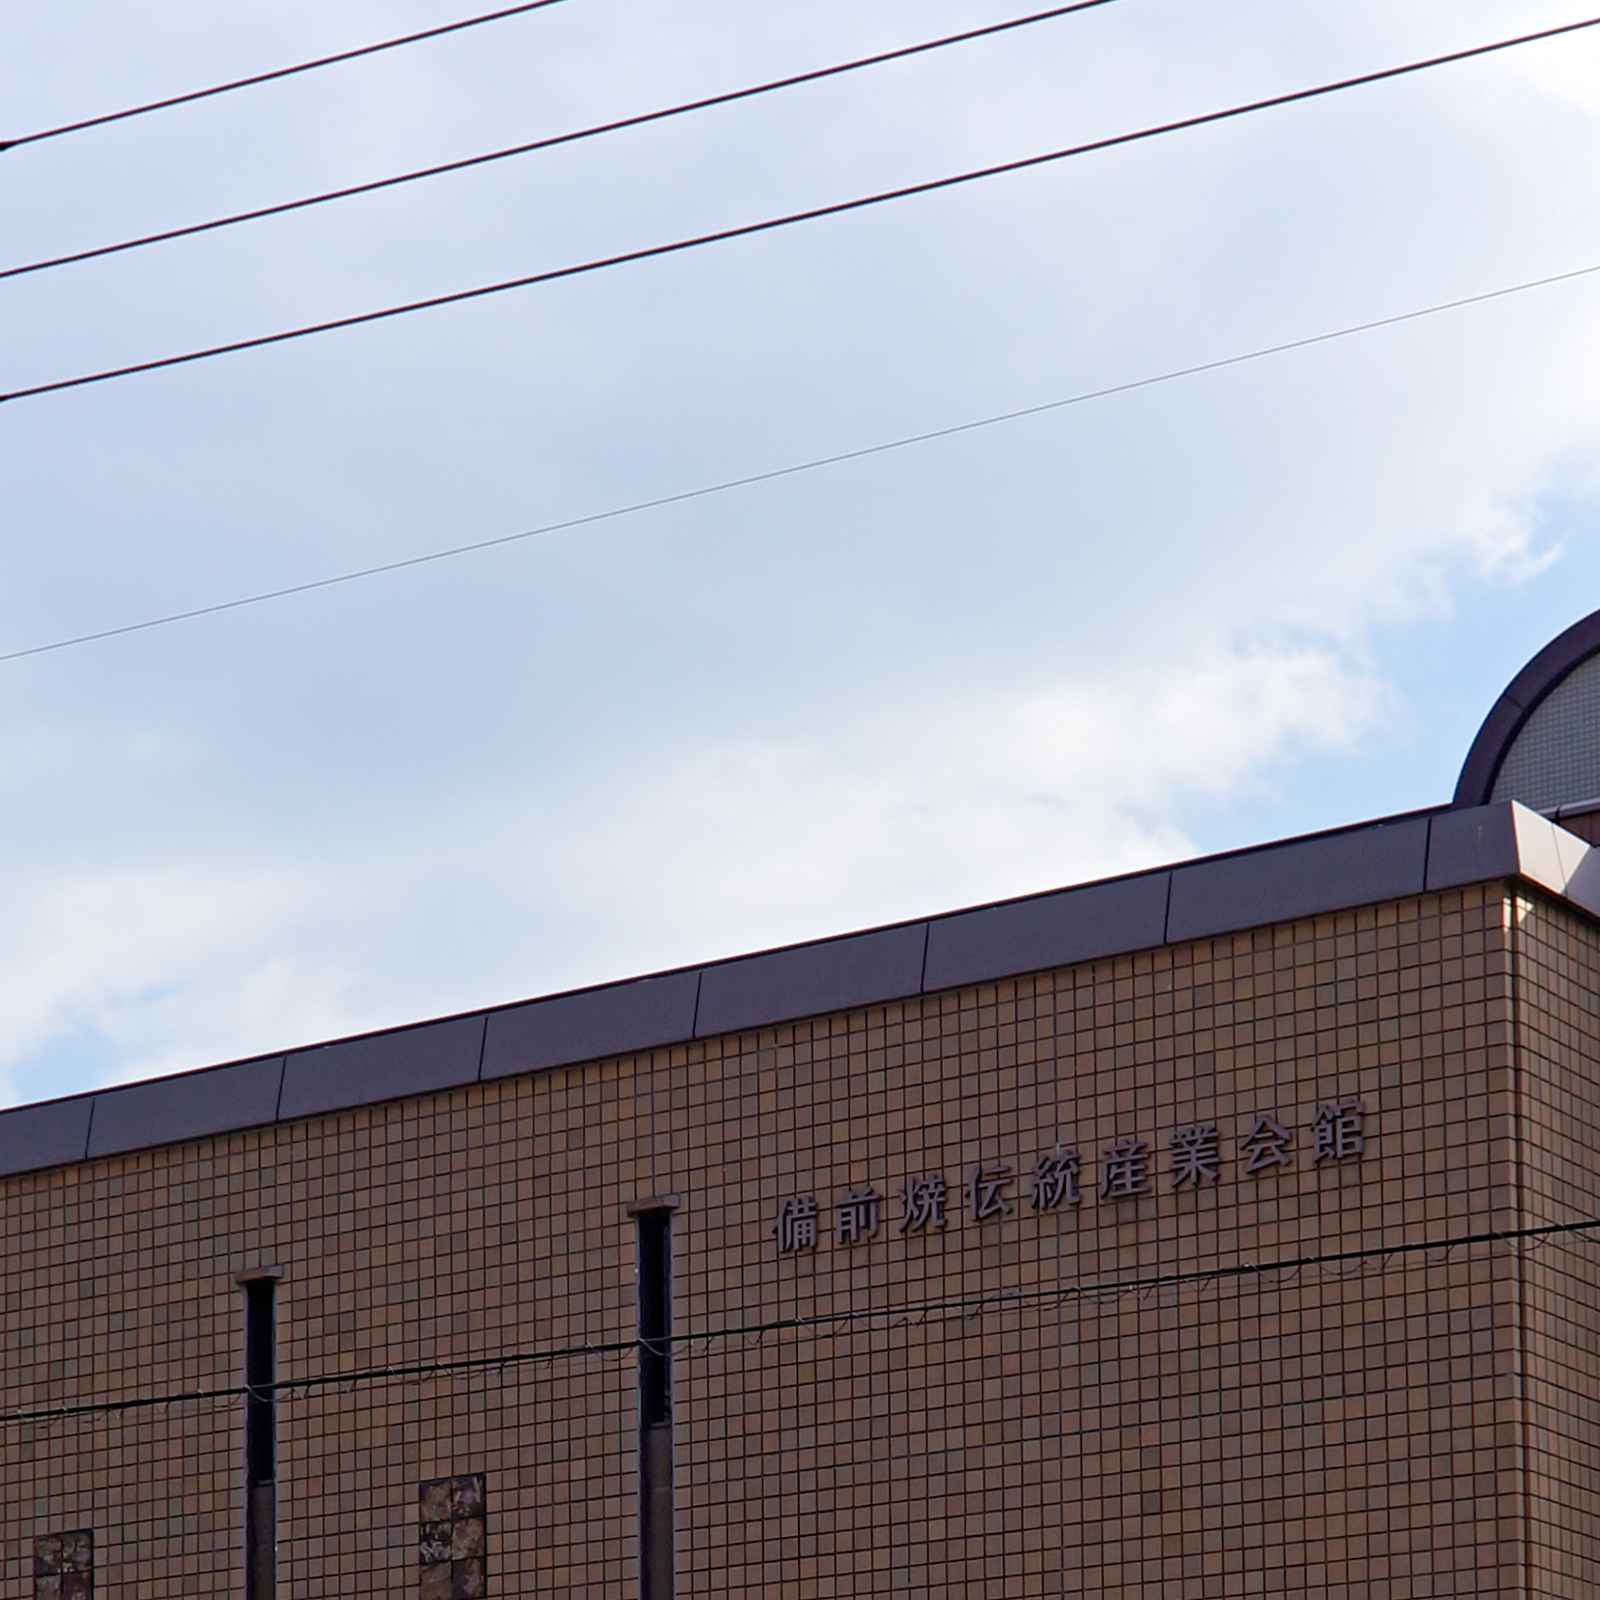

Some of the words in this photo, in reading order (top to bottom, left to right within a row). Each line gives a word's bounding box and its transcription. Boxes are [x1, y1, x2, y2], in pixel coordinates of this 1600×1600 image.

[773, 1100, 1368, 1254] 備前焼伝統産業会館
